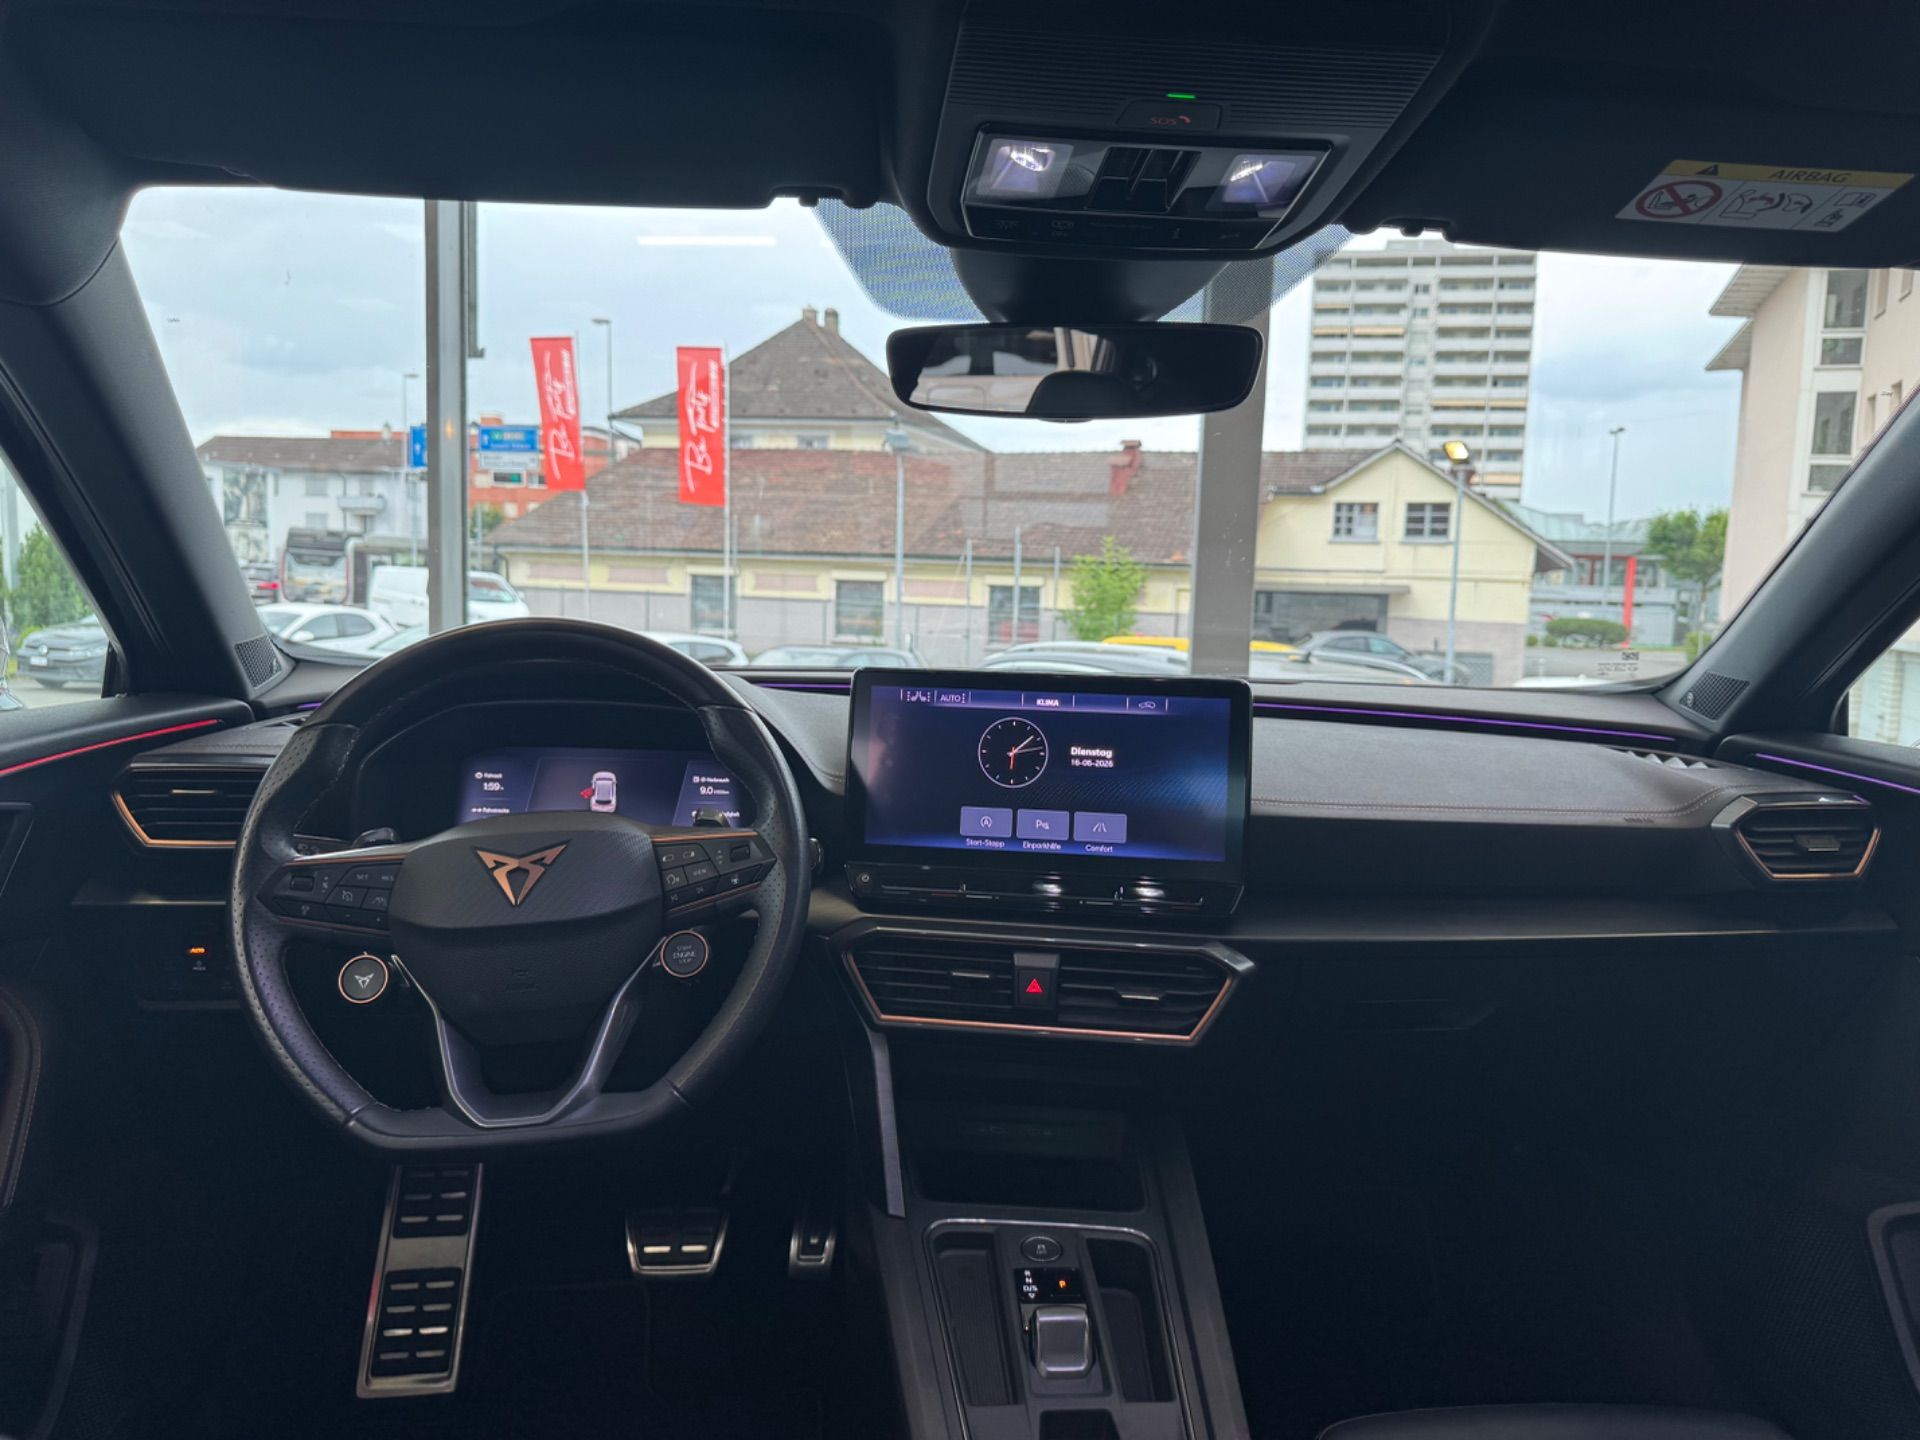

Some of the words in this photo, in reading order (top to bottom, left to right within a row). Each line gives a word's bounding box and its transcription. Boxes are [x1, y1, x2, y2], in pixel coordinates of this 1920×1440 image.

[1151, 116, 1177, 126] SOS
[1769, 169, 1852, 183] AIRBAG
[940, 693, 961, 703] AUTO
[1036, 698, 1059, 707] KLIMA
[1070, 746, 1113, 759] Dienstag
[966, 838, 1005, 848] Start-Stopp
[1023, 841, 1062, 851] Einparkhilfe
[1085, 844, 1114, 853] Comfort
[1058, 1279, 1066, 1289] P
